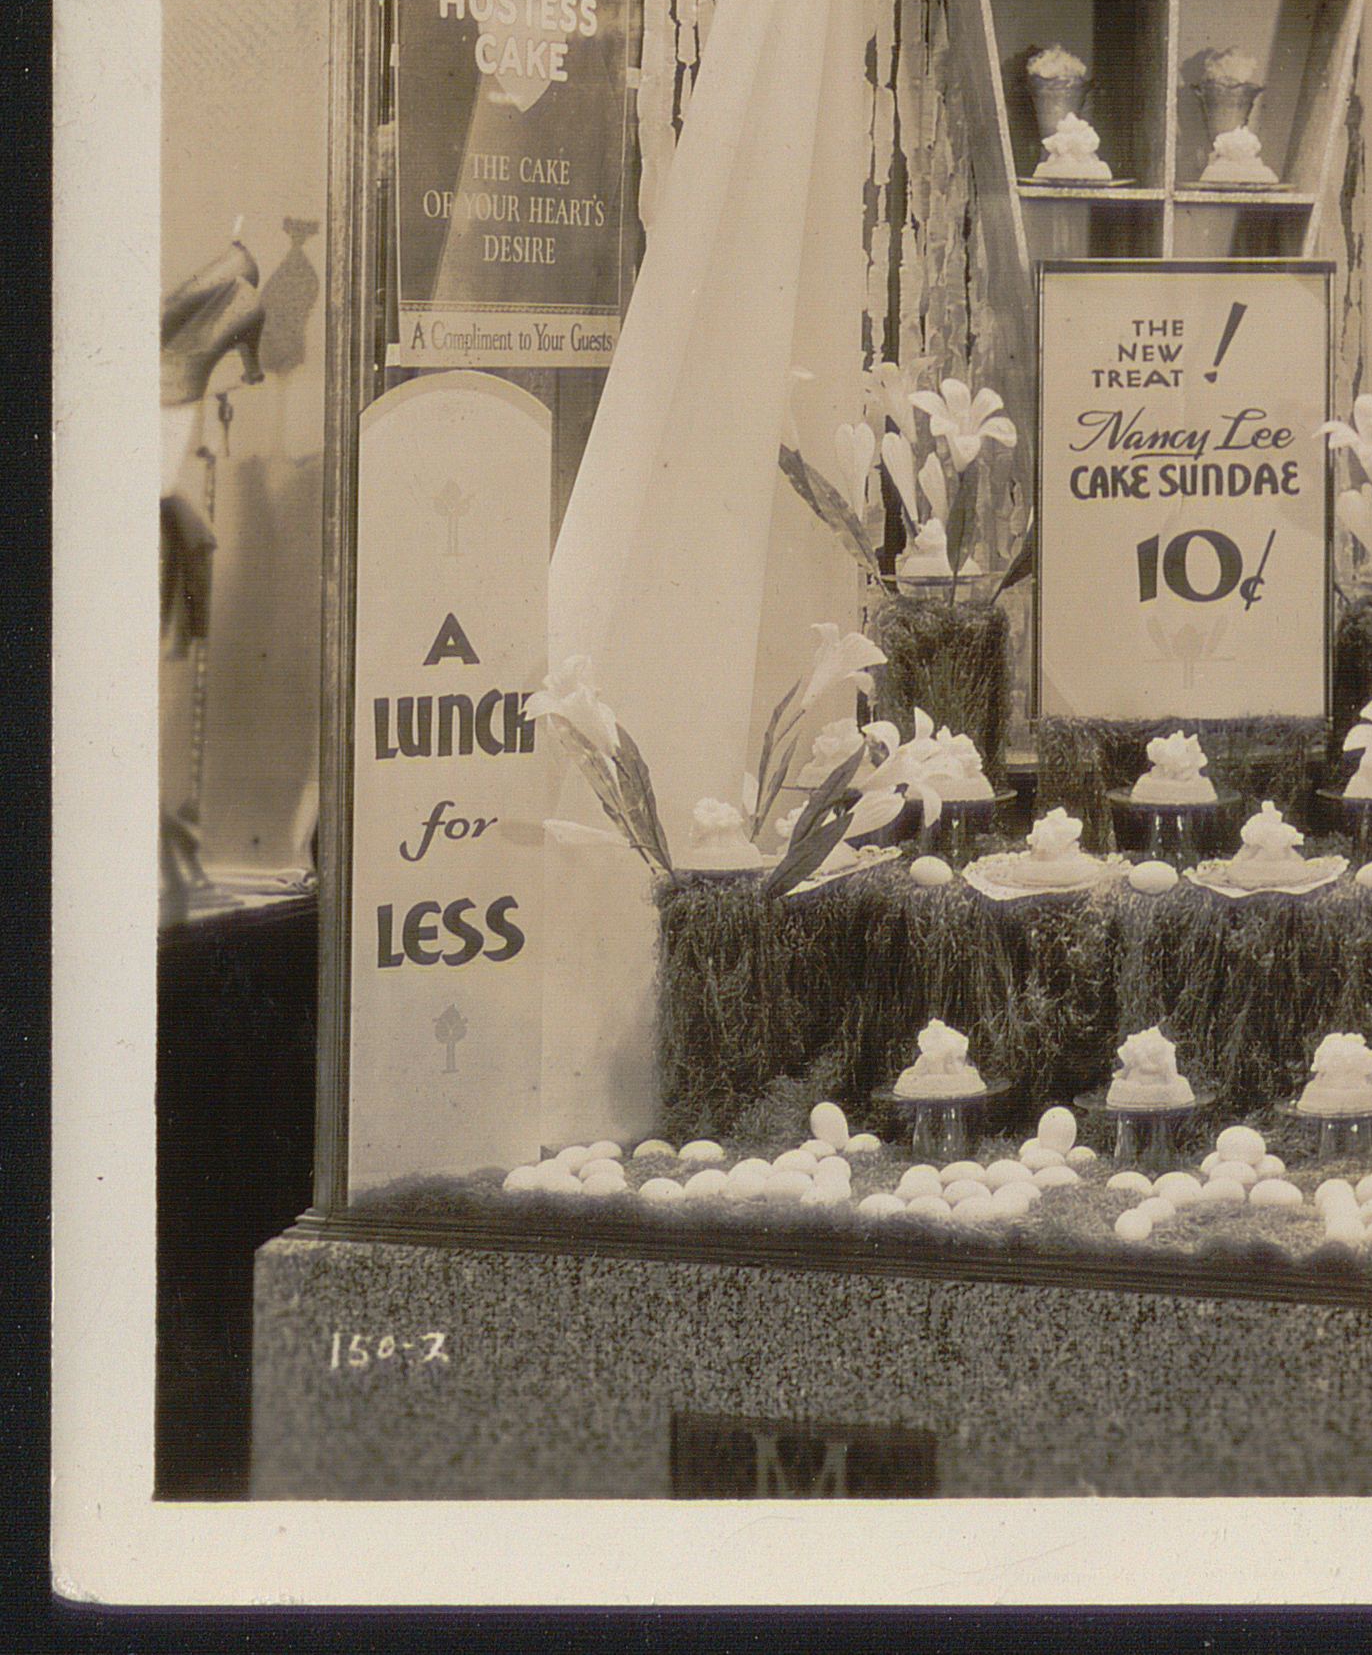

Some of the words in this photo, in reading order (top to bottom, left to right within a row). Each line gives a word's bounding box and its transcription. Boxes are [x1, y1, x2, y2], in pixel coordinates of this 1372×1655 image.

[474, 33, 570, 84] CAKE
[468, 152, 511, 182] THE
[519, 156, 572, 186] CAKE
[422, 189, 455, 220] OF
[464, 192, 521, 223] YOUR
[528, 193, 606, 228] HEART'S
[482, 234, 557, 266] DESIRE
[410, 319, 426, 351] A
[431, 319, 513, 357] Compliment
[518, 330, 532, 352] to
[533, 323, 566, 353] Your
[570, 322, 614, 353] Guests
[1132, 319, 1185, 338] THE
[1117, 343, 1185, 363] NEW
[1091, 369, 1185, 389] TREAT
[1069, 406, 1212, 460] Nancy
[1213, 408, 1296, 451] Lee
[1069, 463, 1152, 500] CAKE
[1157, 460, 1301, 498] SUNDAE
[1136, 528, 1277, 612] 10¢
[422, 611, 480, 666] A
[373, 689, 535, 760] LUNCH
[399, 800, 500, 862] for
[375, 894, 526, 969] LESS
